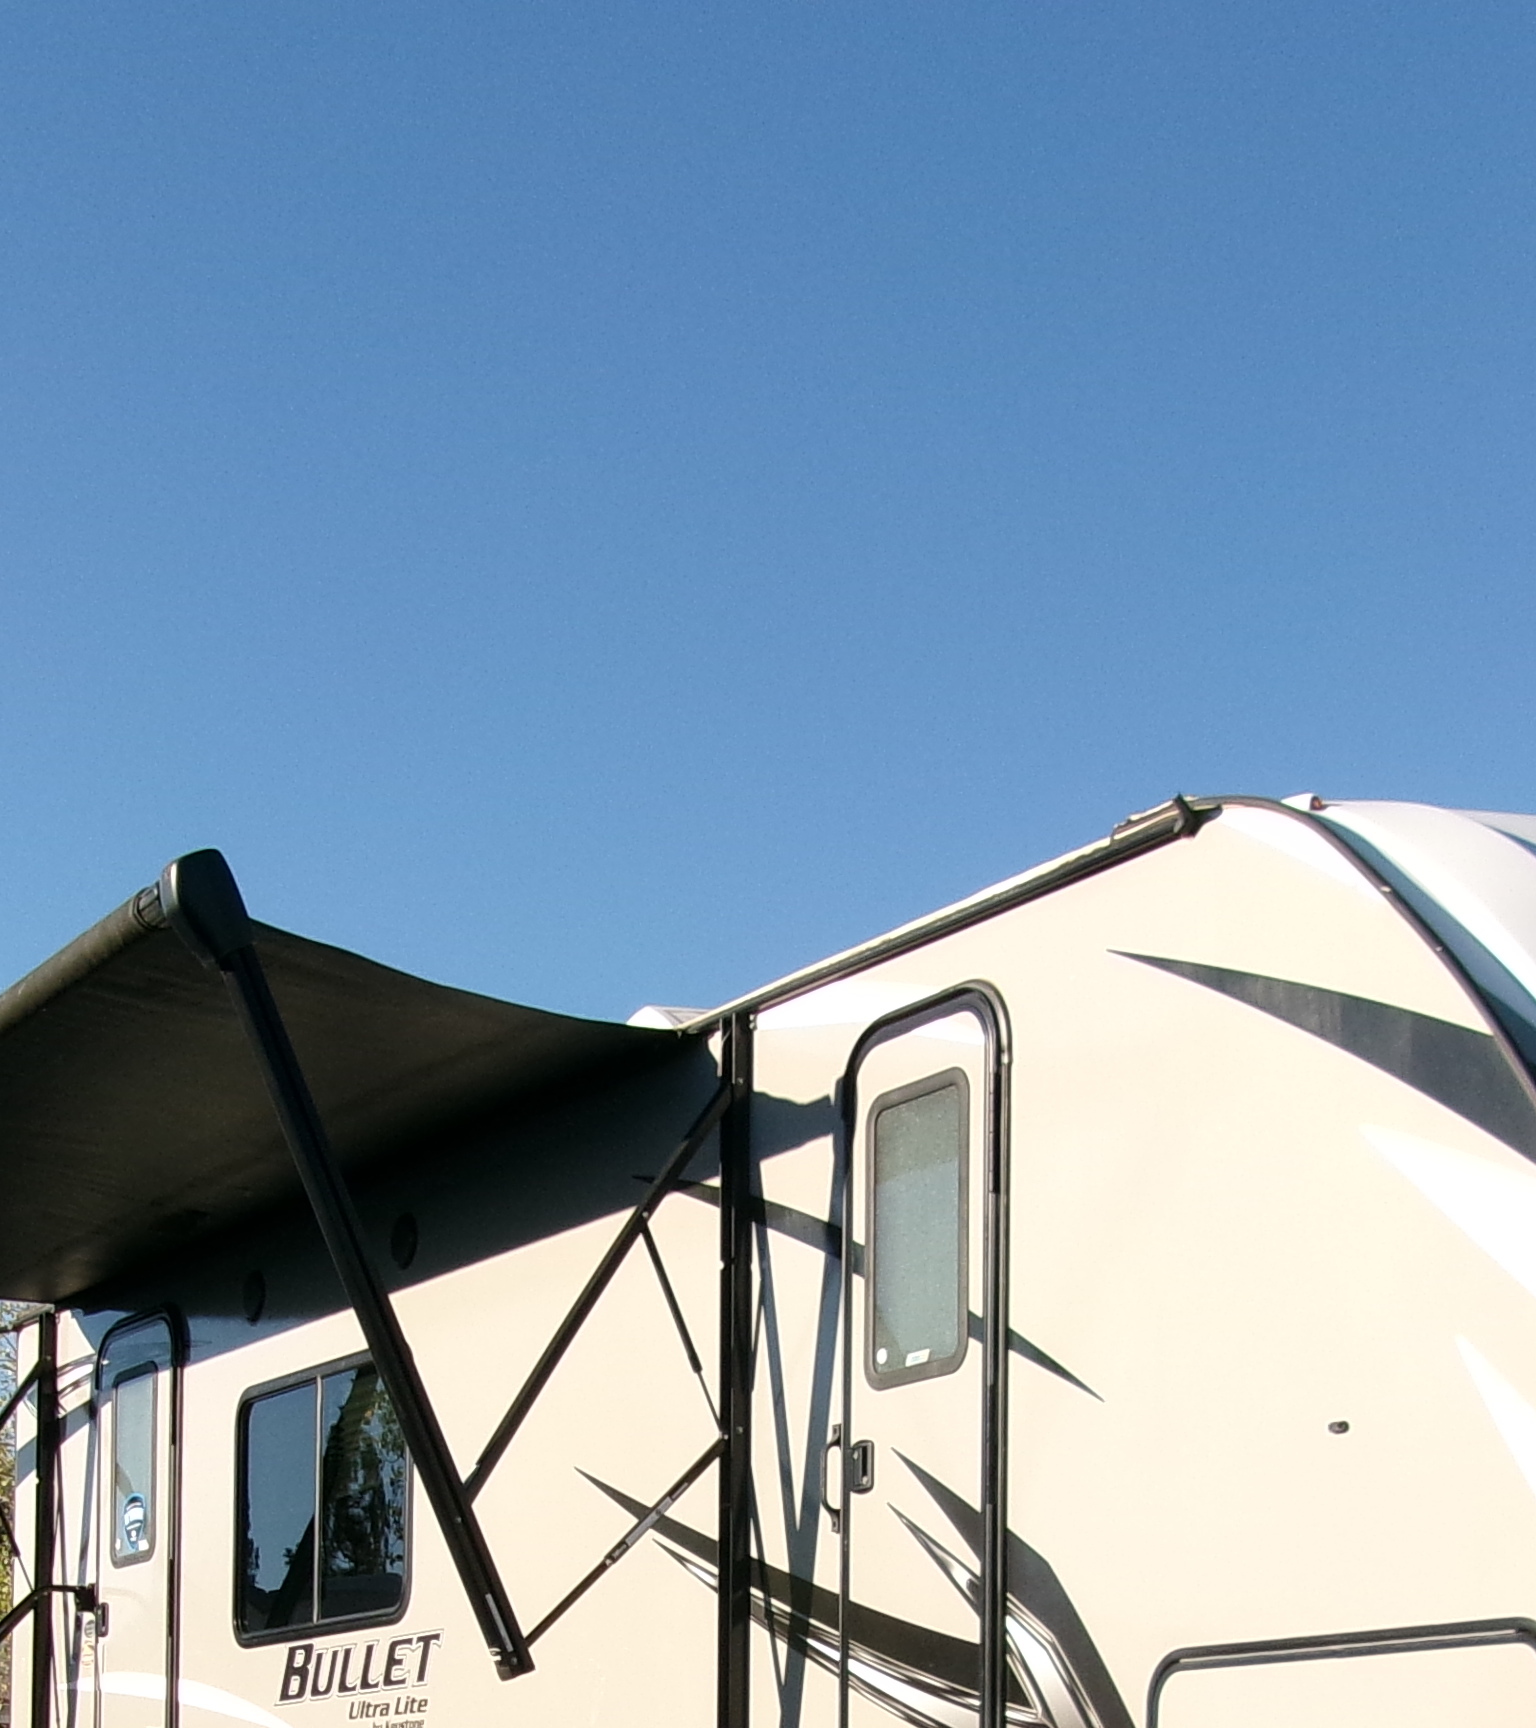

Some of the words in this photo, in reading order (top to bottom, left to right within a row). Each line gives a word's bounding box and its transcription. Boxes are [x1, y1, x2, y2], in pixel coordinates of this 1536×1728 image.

[274, 1629, 444, 1706] BULLET
[349, 1700, 390, 1720] Ultra
[394, 1696, 429, 1716] Lite
